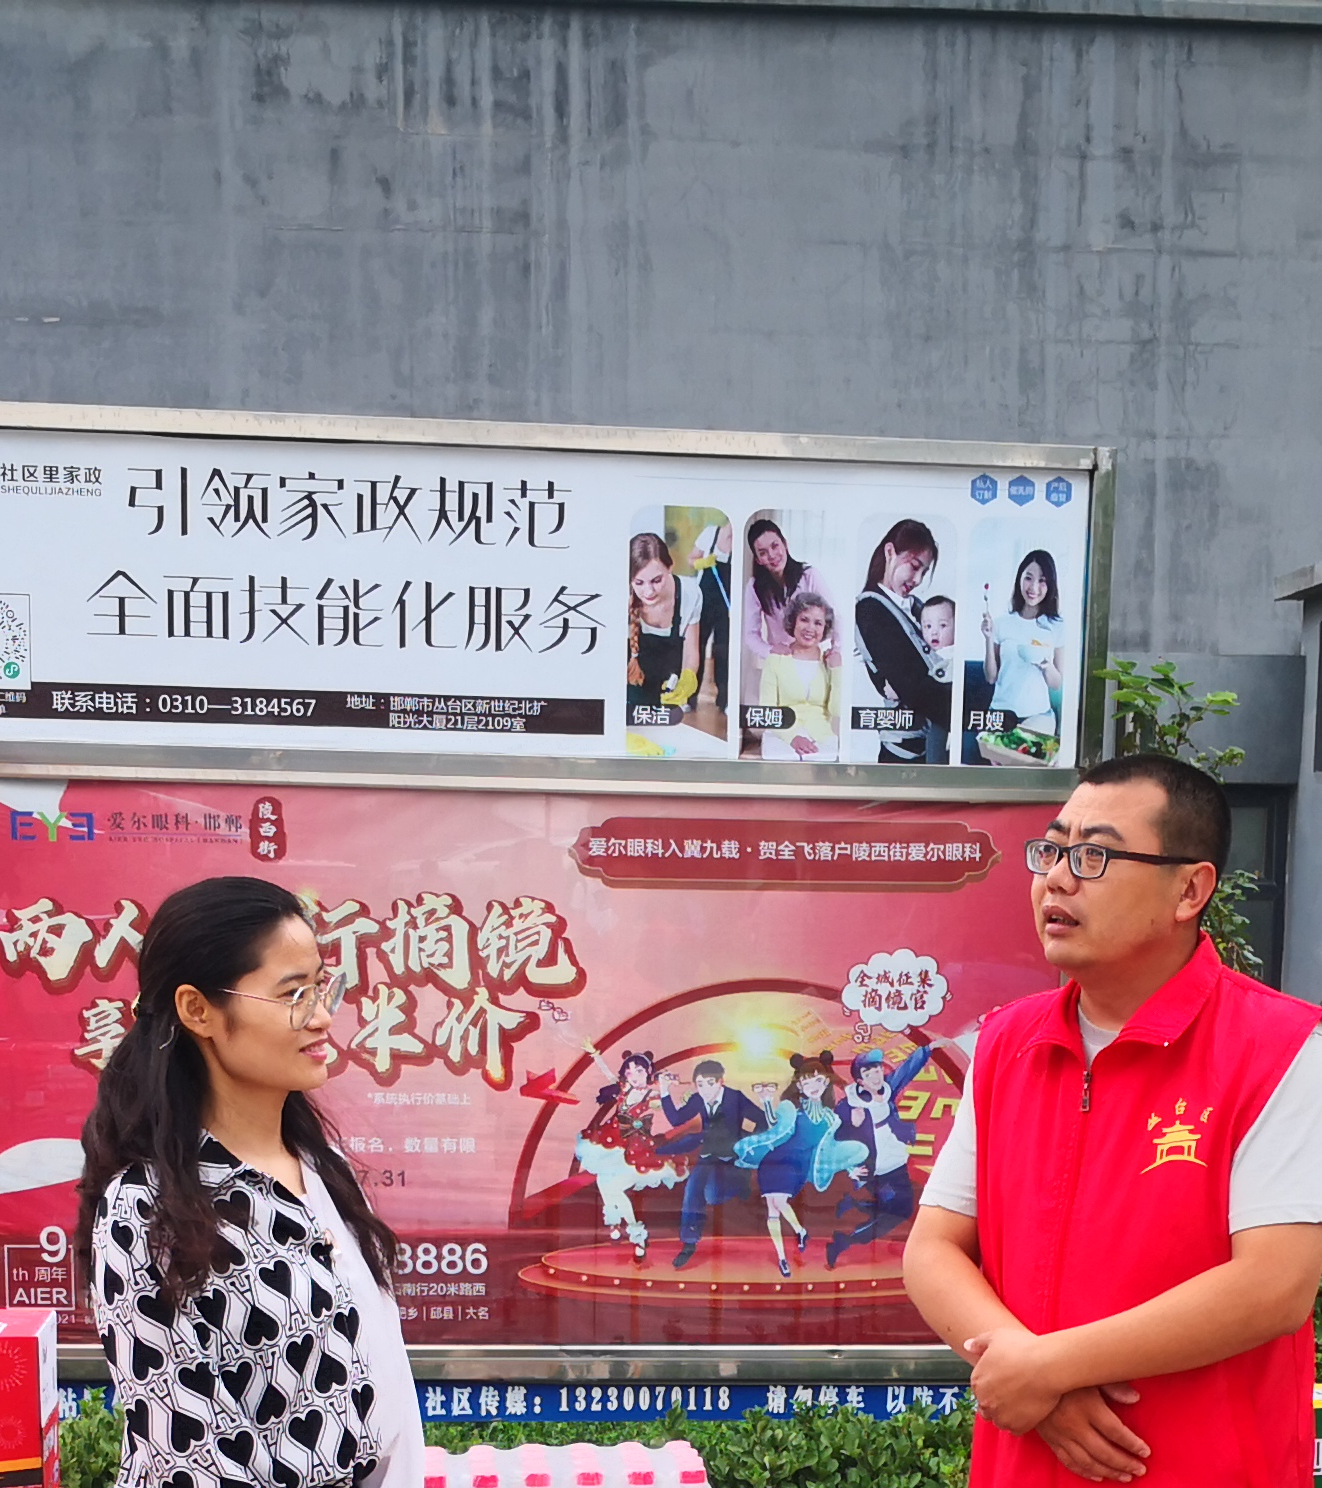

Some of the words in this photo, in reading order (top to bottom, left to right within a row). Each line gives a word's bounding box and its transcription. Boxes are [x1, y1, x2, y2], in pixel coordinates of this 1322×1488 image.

[0, 462, 103, 487] 社区里家政
[0, 485, 102, 498] SHEQULIJIAZHENG
[126, 466, 572, 549] 引领家政规范
[86, 569, 607, 655] 全面技能化服务
[388, 713, 527, 732] 阳光大厦21层2109室
[632, 705, 671, 726] 保洁
[745, 707, 784, 728] 保姆
[857, 709, 914, 730] 育婴师
[967, 710, 1005, 732] 月嫂
[10, 811, 95, 841] EYE
[257, 801, 278, 858] 陵西街
[854, 969, 935, 990] 全城征集
[861, 990, 929, 1013] 摘镜官
[39, 1225, 67, 1263] 9
[12, 1267, 29, 1282] th
[34, 1266, 68, 1283] 周年
[12, 1287, 69, 1305] AIER
[466, 1307, 489, 1320] 大名
[559, 1386, 730, 1412] 13230070118
